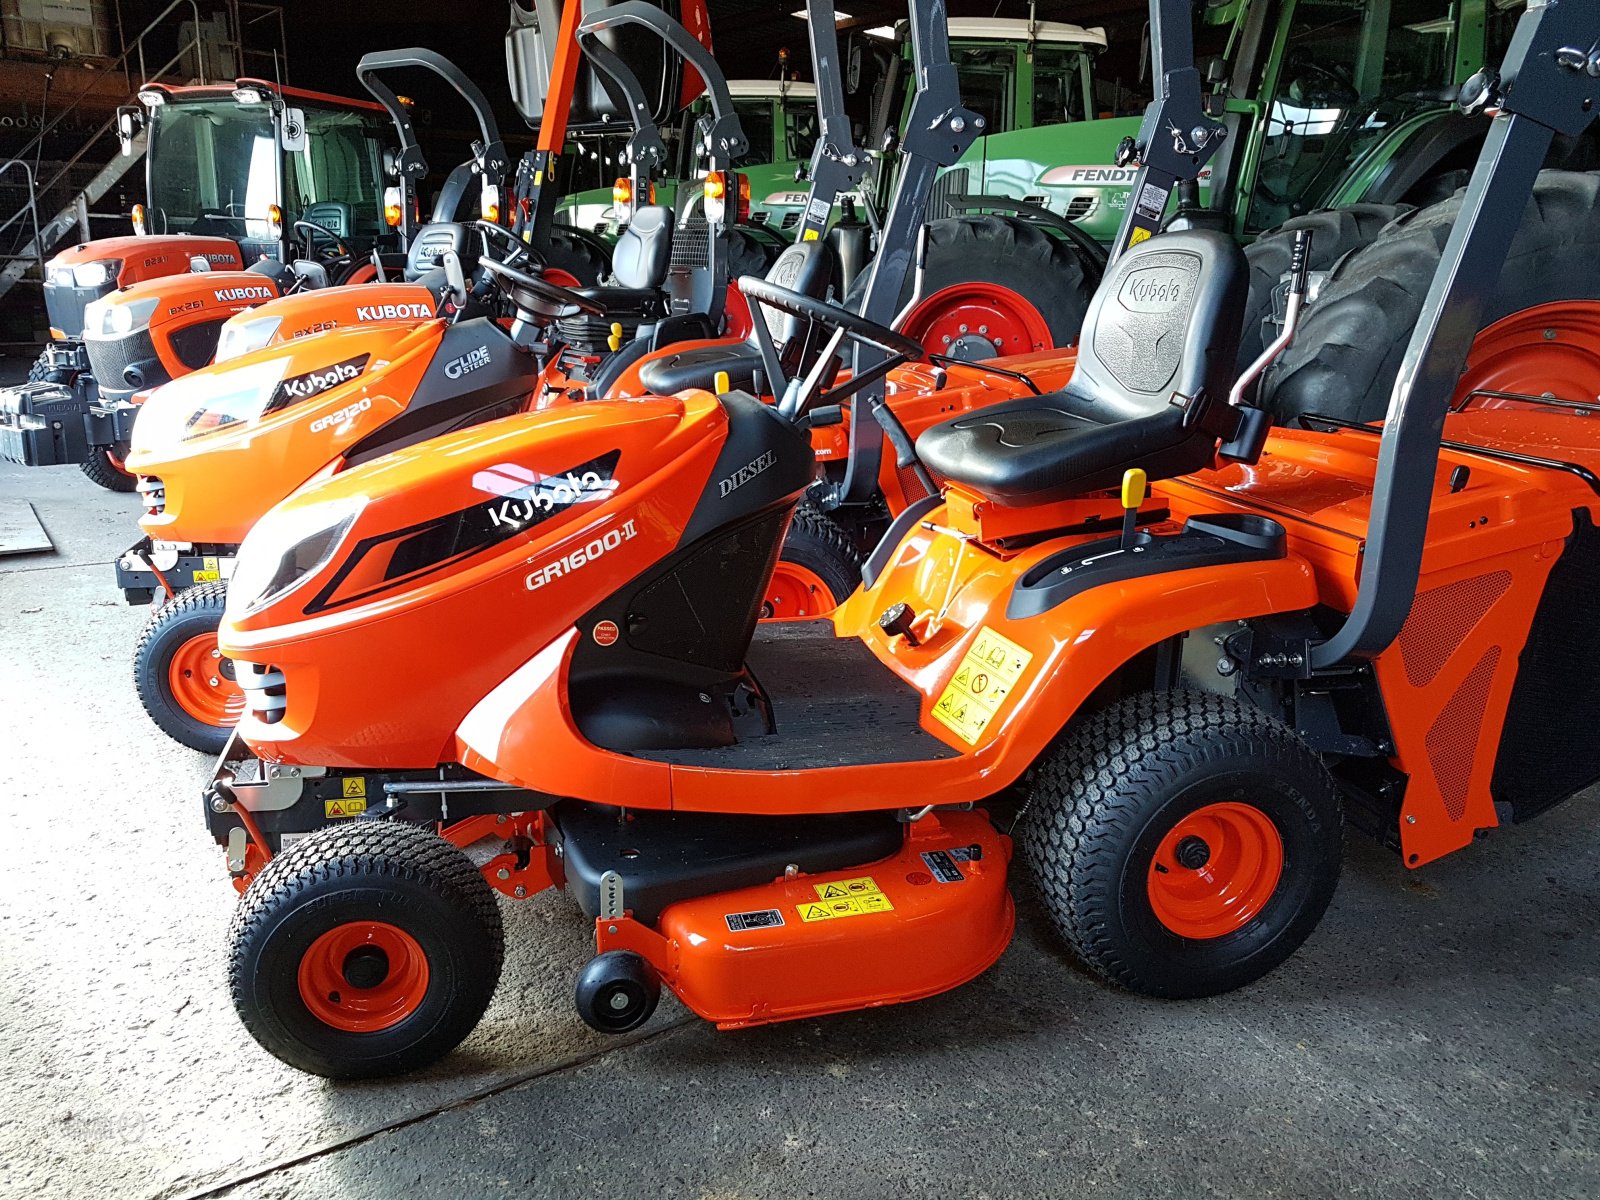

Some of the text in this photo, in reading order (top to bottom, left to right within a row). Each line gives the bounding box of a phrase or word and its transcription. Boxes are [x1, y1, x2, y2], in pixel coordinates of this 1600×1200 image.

[1071, 169, 1138, 181] FENDT
[214, 287, 274, 302] KUBOTA
[1129, 278, 1180, 302] Kubota
[169, 300, 204, 316] BX261
[355, 304, 433, 322] KUBOTA
[444, 345, 488, 380] GLIDE
[463, 356, 491, 374] STEER
[284, 364, 359, 397] Kubota
[309, 397, 373, 433] GR2120
[719, 449, 777, 498] DIESEL
[487, 471, 606, 529] Kubota
